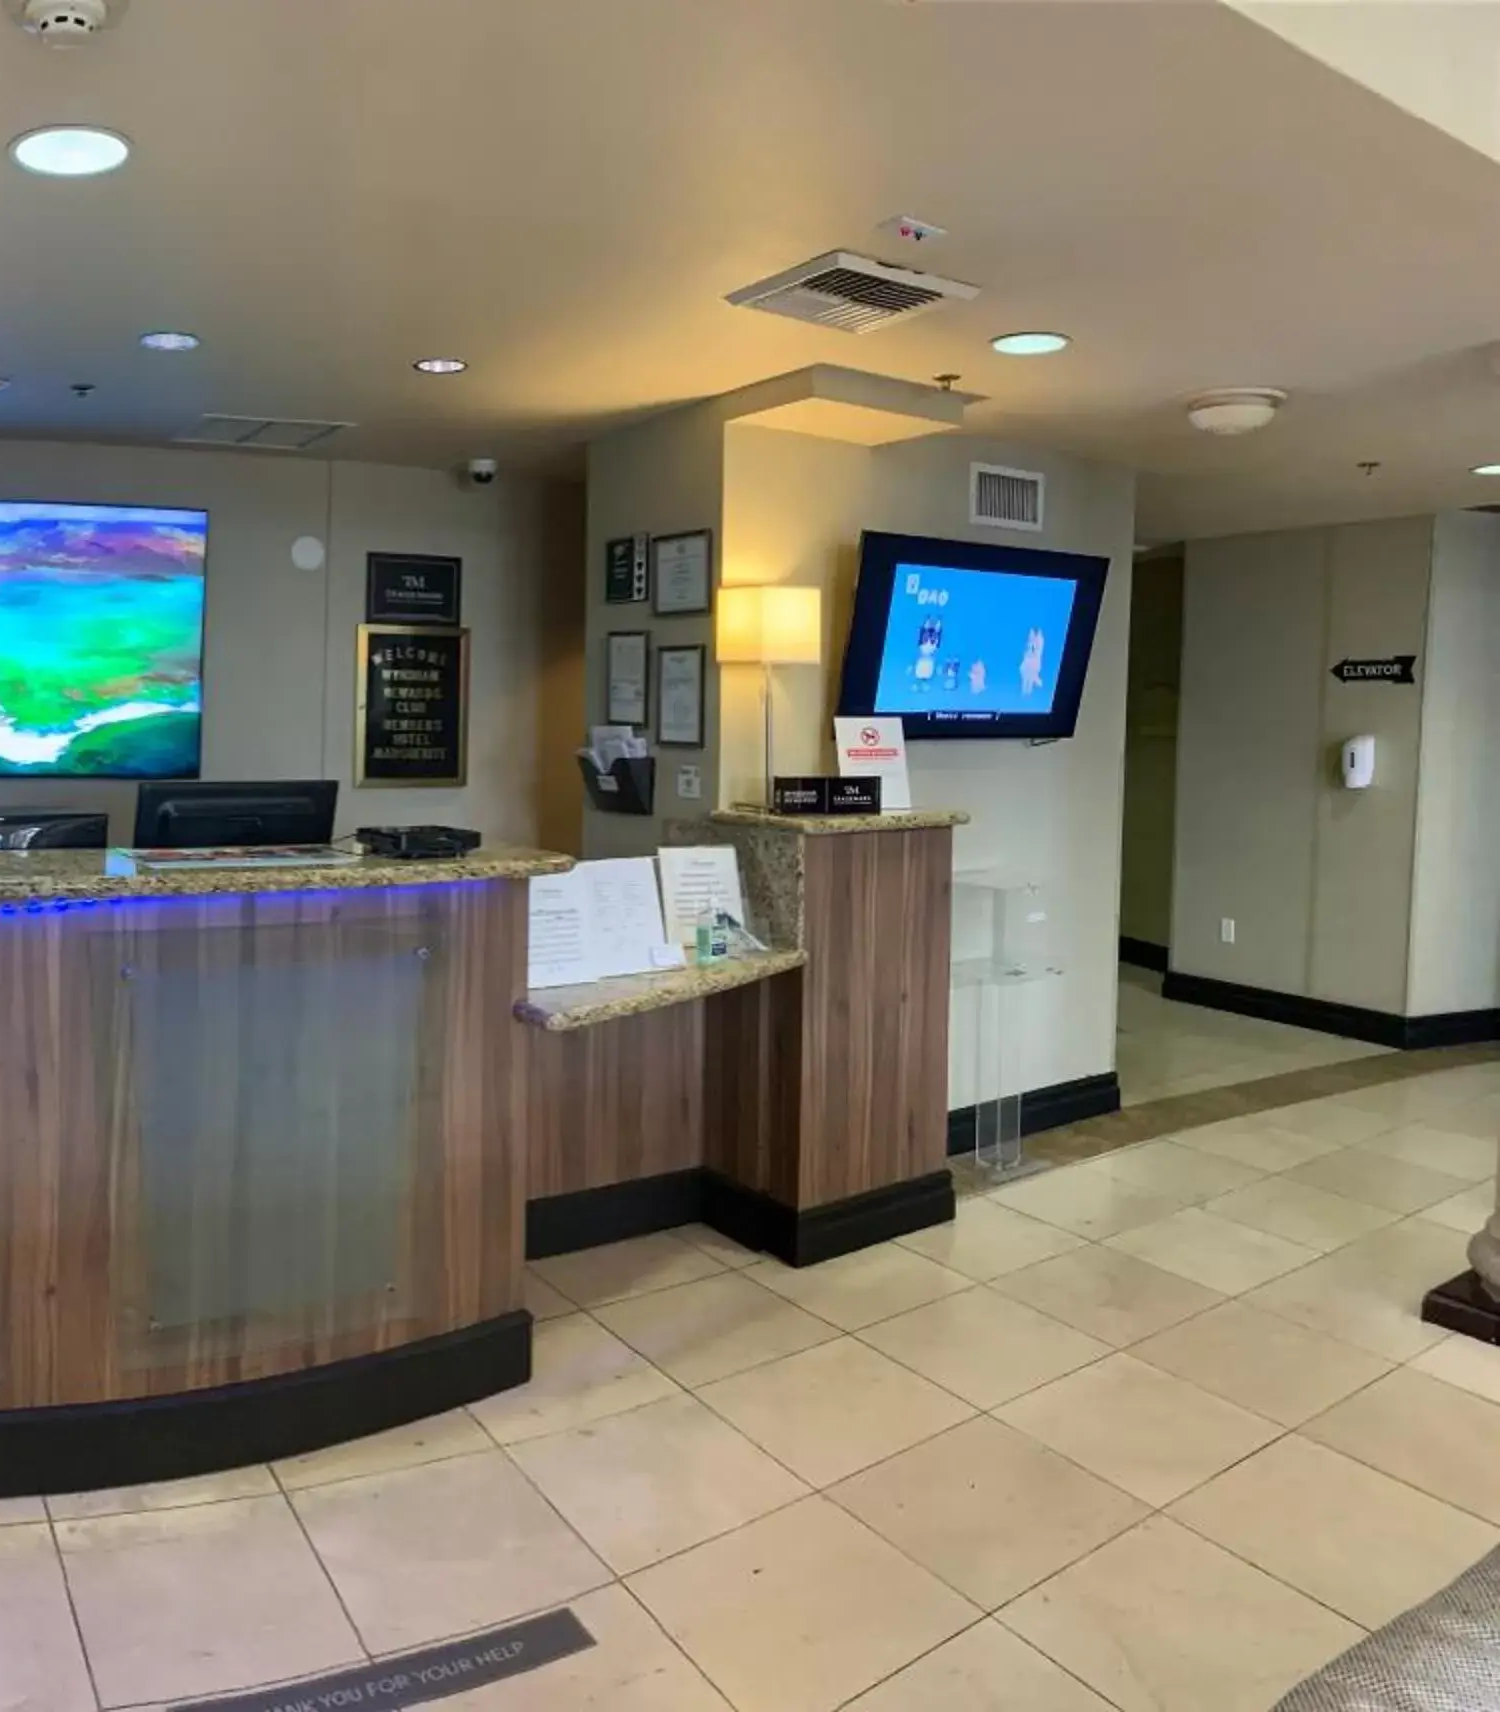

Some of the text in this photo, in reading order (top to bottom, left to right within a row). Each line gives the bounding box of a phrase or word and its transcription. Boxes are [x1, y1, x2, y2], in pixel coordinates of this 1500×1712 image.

[370, 646, 448, 667] WELCOME
[1343, 663, 1403, 677] ELEVATOR
[383, 687, 443, 700] REWARDS
[318, 1687, 363, 1708] YOU
[365, 1674, 410, 1697] FOR
[411, 1658, 473, 1684] YOUR
[475, 1642, 524, 1666] HELP
